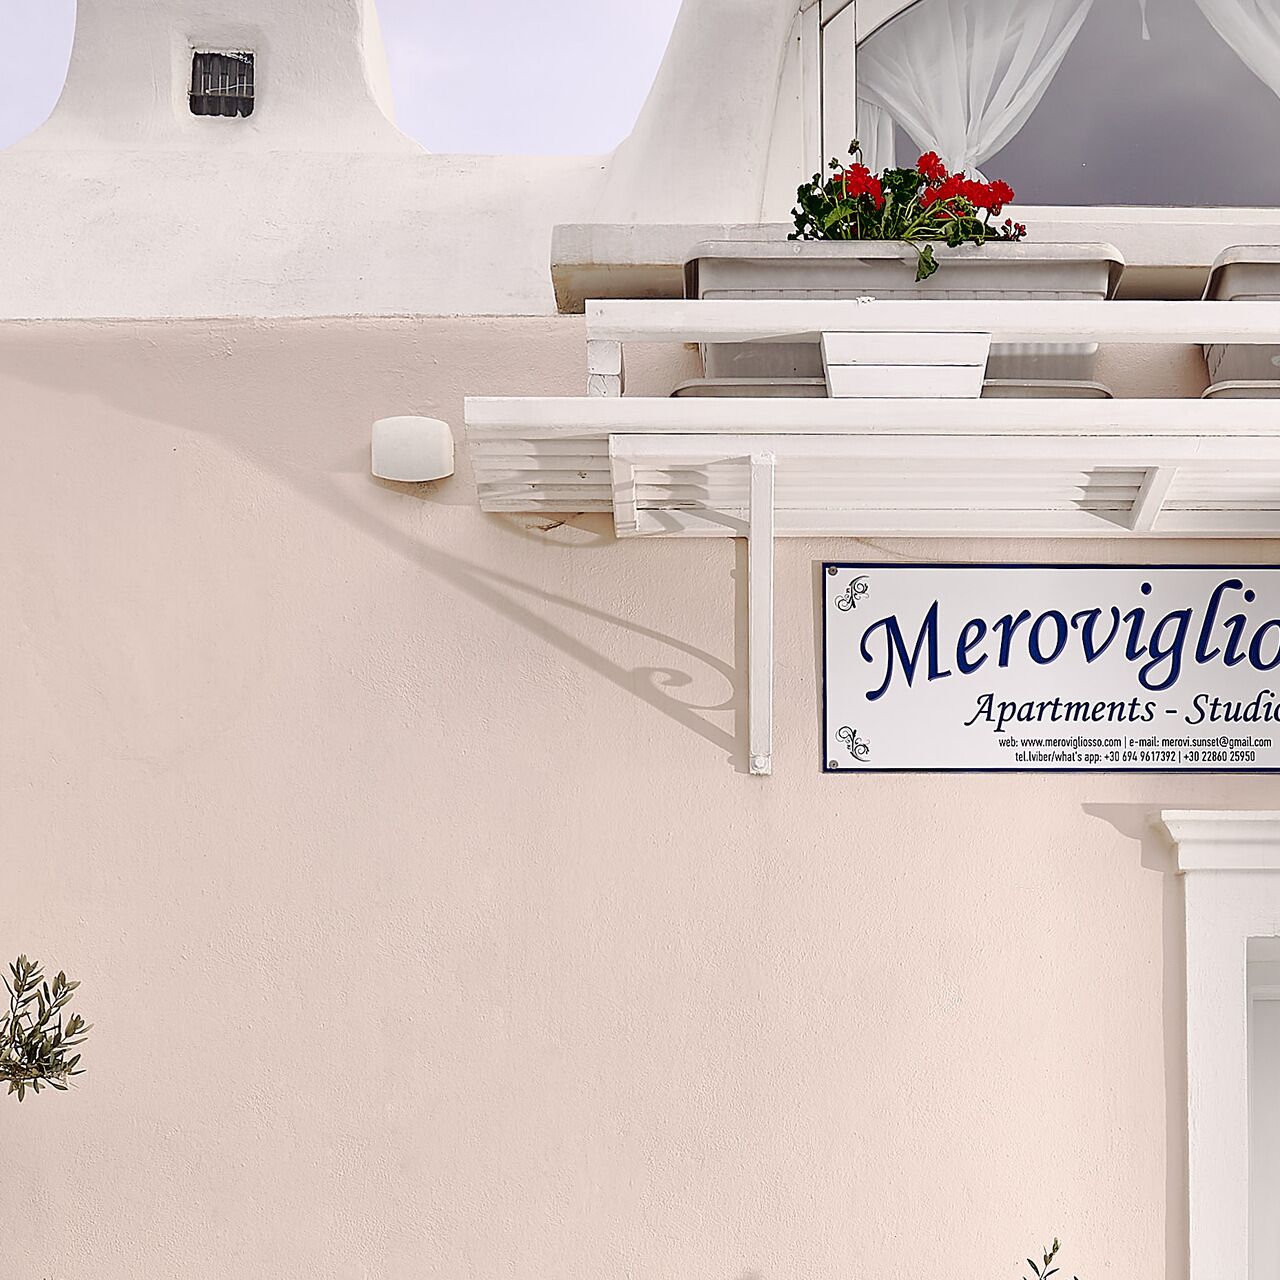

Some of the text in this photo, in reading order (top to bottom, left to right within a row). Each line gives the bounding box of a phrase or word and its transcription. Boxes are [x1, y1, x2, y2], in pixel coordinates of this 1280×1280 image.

[964, 693, 1156, 732] Apartments
[998, 736, 1019, 747] web:
[1021, 735, 1122, 750] www.merovigliosso.com
[1129, 736, 1160, 747] e-mail:
[1161, 736, 1272, 750] merovi.sunset@gmail.com
[1084, 752, 1102, 764] app:
[1104, 751, 1120, 762] +30
[1122, 751, 1138, 762] 694
[1140, 751, 1176, 762] 9617392
[1183, 751, 1200, 762] +30
[1201, 751, 1228, 762] 22860
[1229, 751, 1256, 762] 25950
